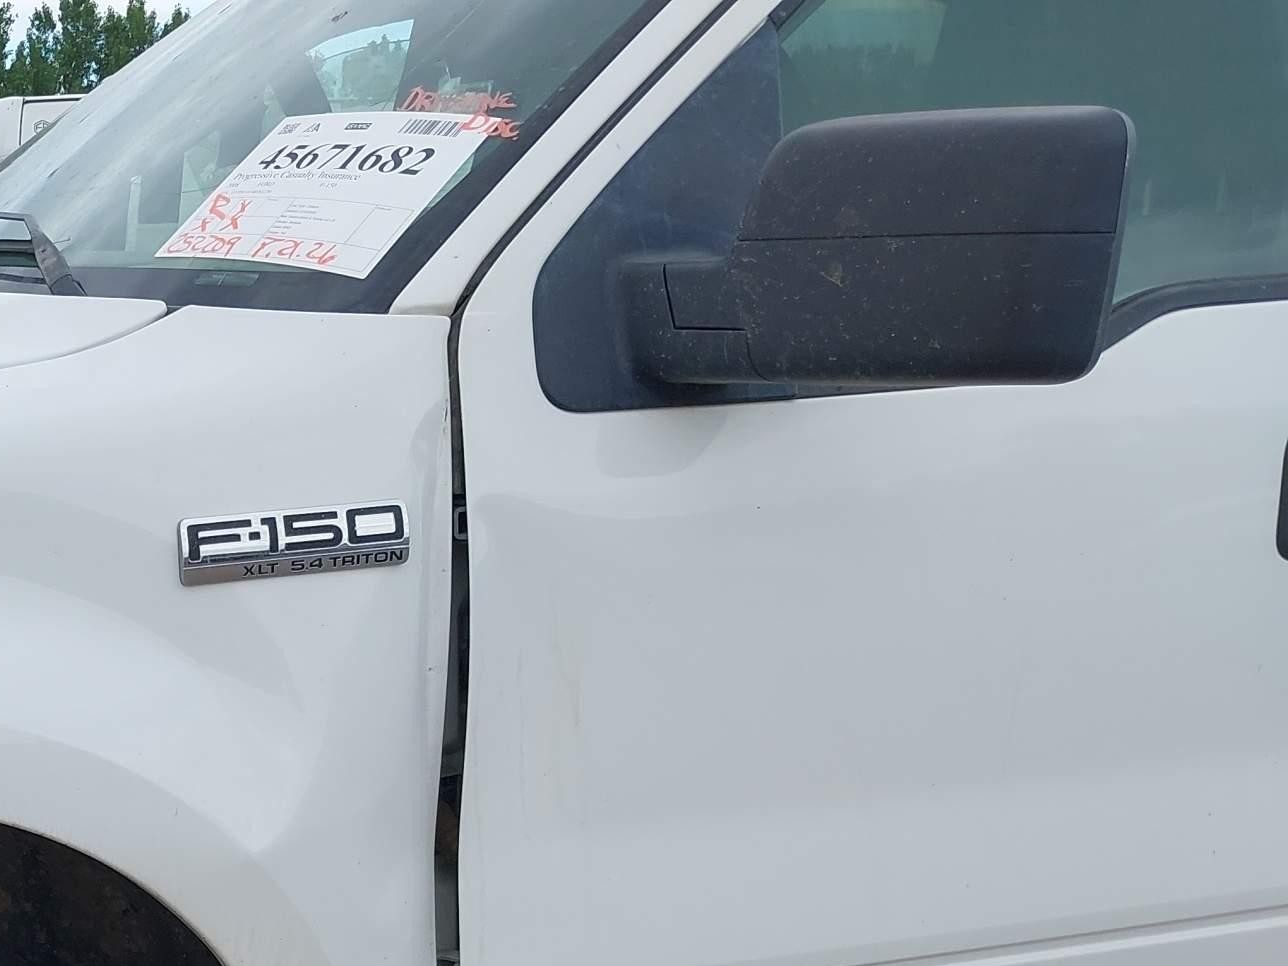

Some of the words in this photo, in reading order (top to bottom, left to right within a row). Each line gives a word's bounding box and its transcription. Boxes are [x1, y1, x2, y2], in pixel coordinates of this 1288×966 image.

[259, 143, 435, 175] 45671682
[233, 172, 280, 181] Progressive
[280, 170, 315, 180] Casualty
[318, 171, 361, 181] Insurance
[187, 504, 405, 562] F-150
[243, 563, 279, 577] XLT
[291, 558, 324, 572] 5.4
[329, 550, 404, 567] TRITON
